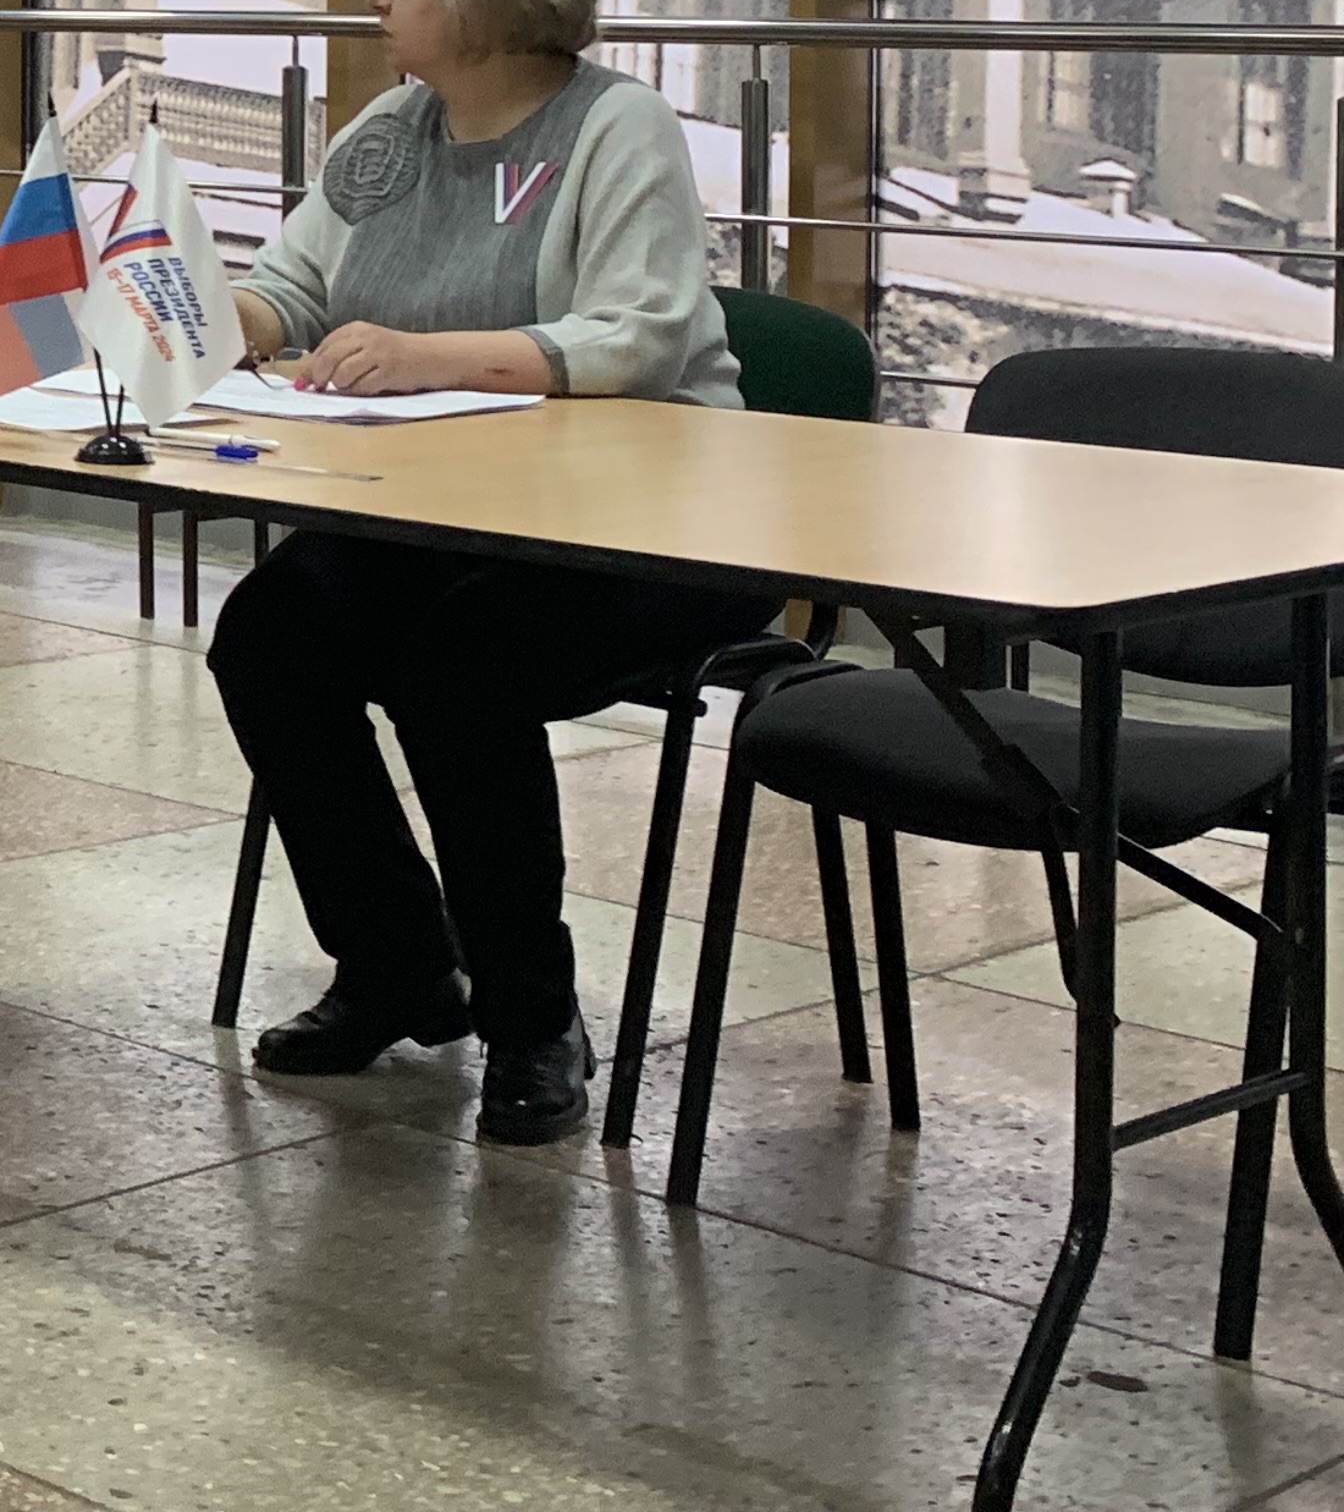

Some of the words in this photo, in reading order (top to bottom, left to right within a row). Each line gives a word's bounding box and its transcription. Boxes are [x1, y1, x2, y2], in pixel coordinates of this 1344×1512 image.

[123, 262, 173, 322] РОССИИ
[124, 296, 160, 333] МАРТА
[147, 258, 206, 359] ПРЕЗИДЕНТА
[167, 257, 208, 327] ВЫБОРЫ
